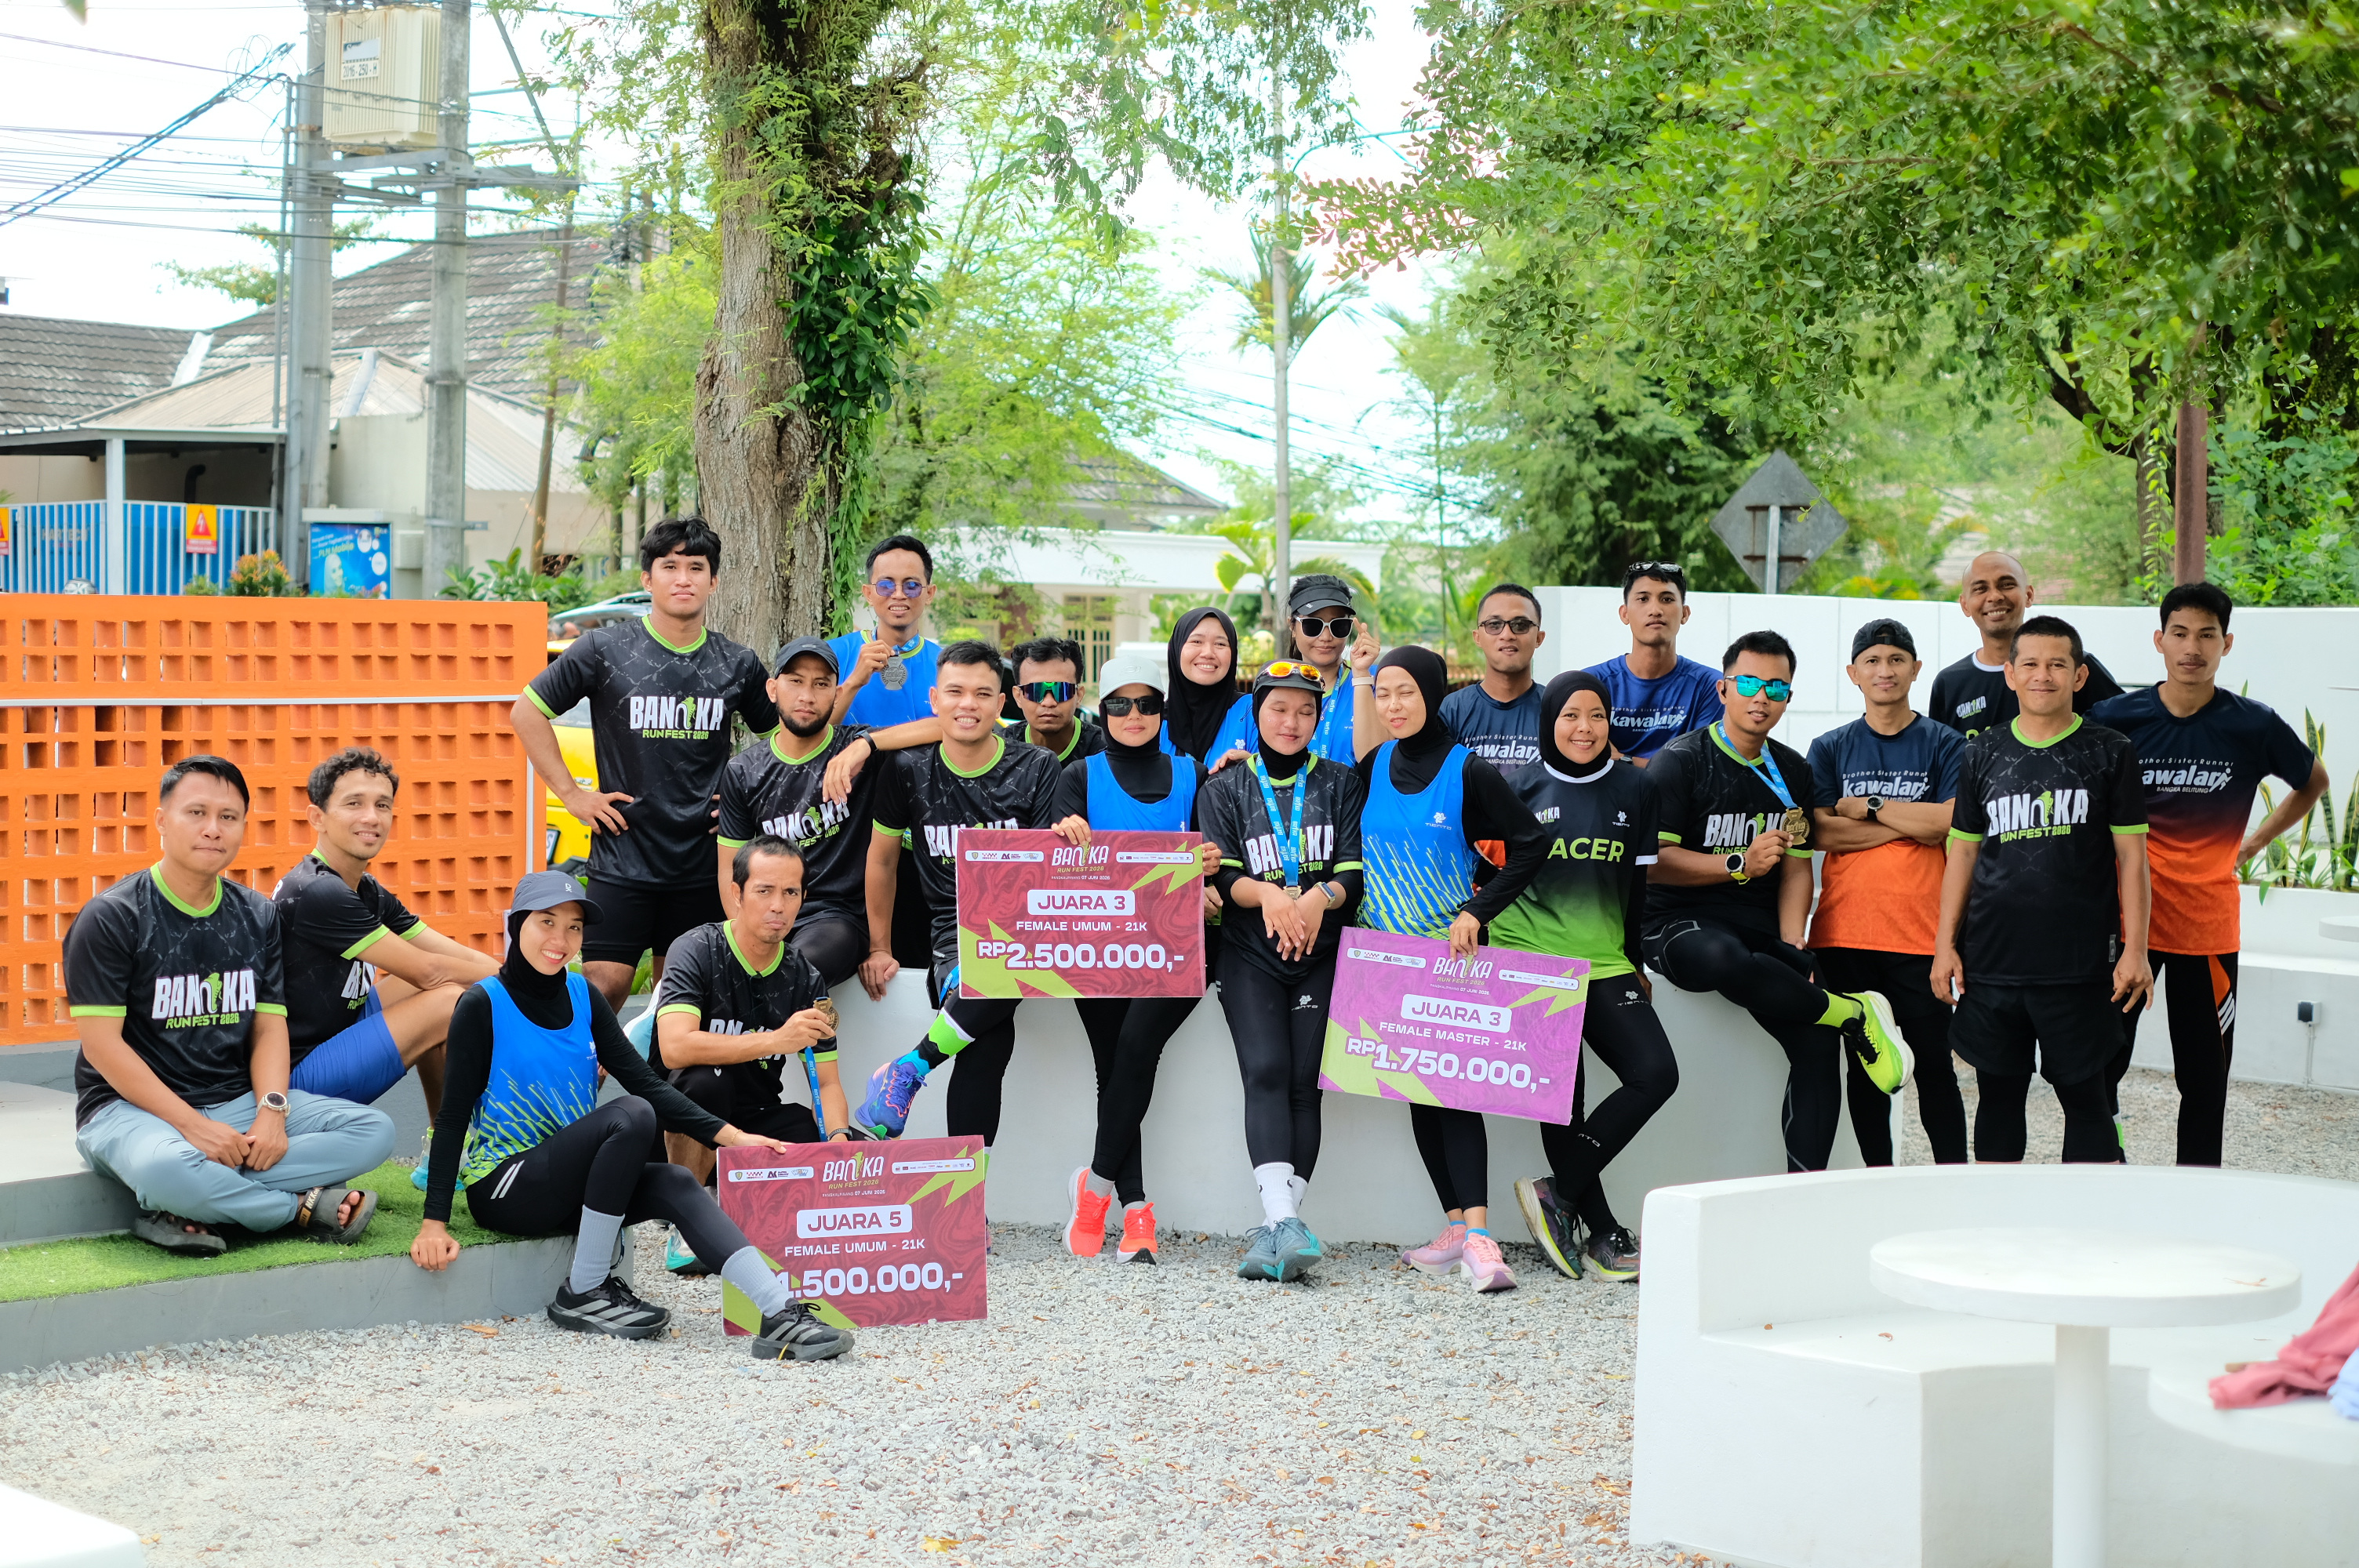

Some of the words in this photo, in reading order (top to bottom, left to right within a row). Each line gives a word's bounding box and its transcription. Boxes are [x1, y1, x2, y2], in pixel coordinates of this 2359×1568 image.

[1547, 837, 1624, 862] ACER
[1038, 895, 1107, 910] JUARA
[1114, 895, 1125, 910] 3
[1016, 921, 1067, 931] FEMALE
[1072, 922, 1111, 931] UMUM
[1125, 922, 1147, 931] 21K
[1412, 1001, 1481, 1024] JUARA
[1489, 1011, 1501, 1026] 3
[1379, 1022, 1431, 1037] FEMALE
[1436, 1030, 1490, 1046] MASTER
[1503, 1040, 1527, 1051] 21K
[808, 1213, 882, 1232] JUARA
[889, 1211, 901, 1228] 5
[785, 1244, 840, 1257] FEMALE
[845, 1241, 886, 1254] UMUM
[902, 1239, 925, 1250] 21K
[777, 1261, 963, 1298] 1.500.000,-
